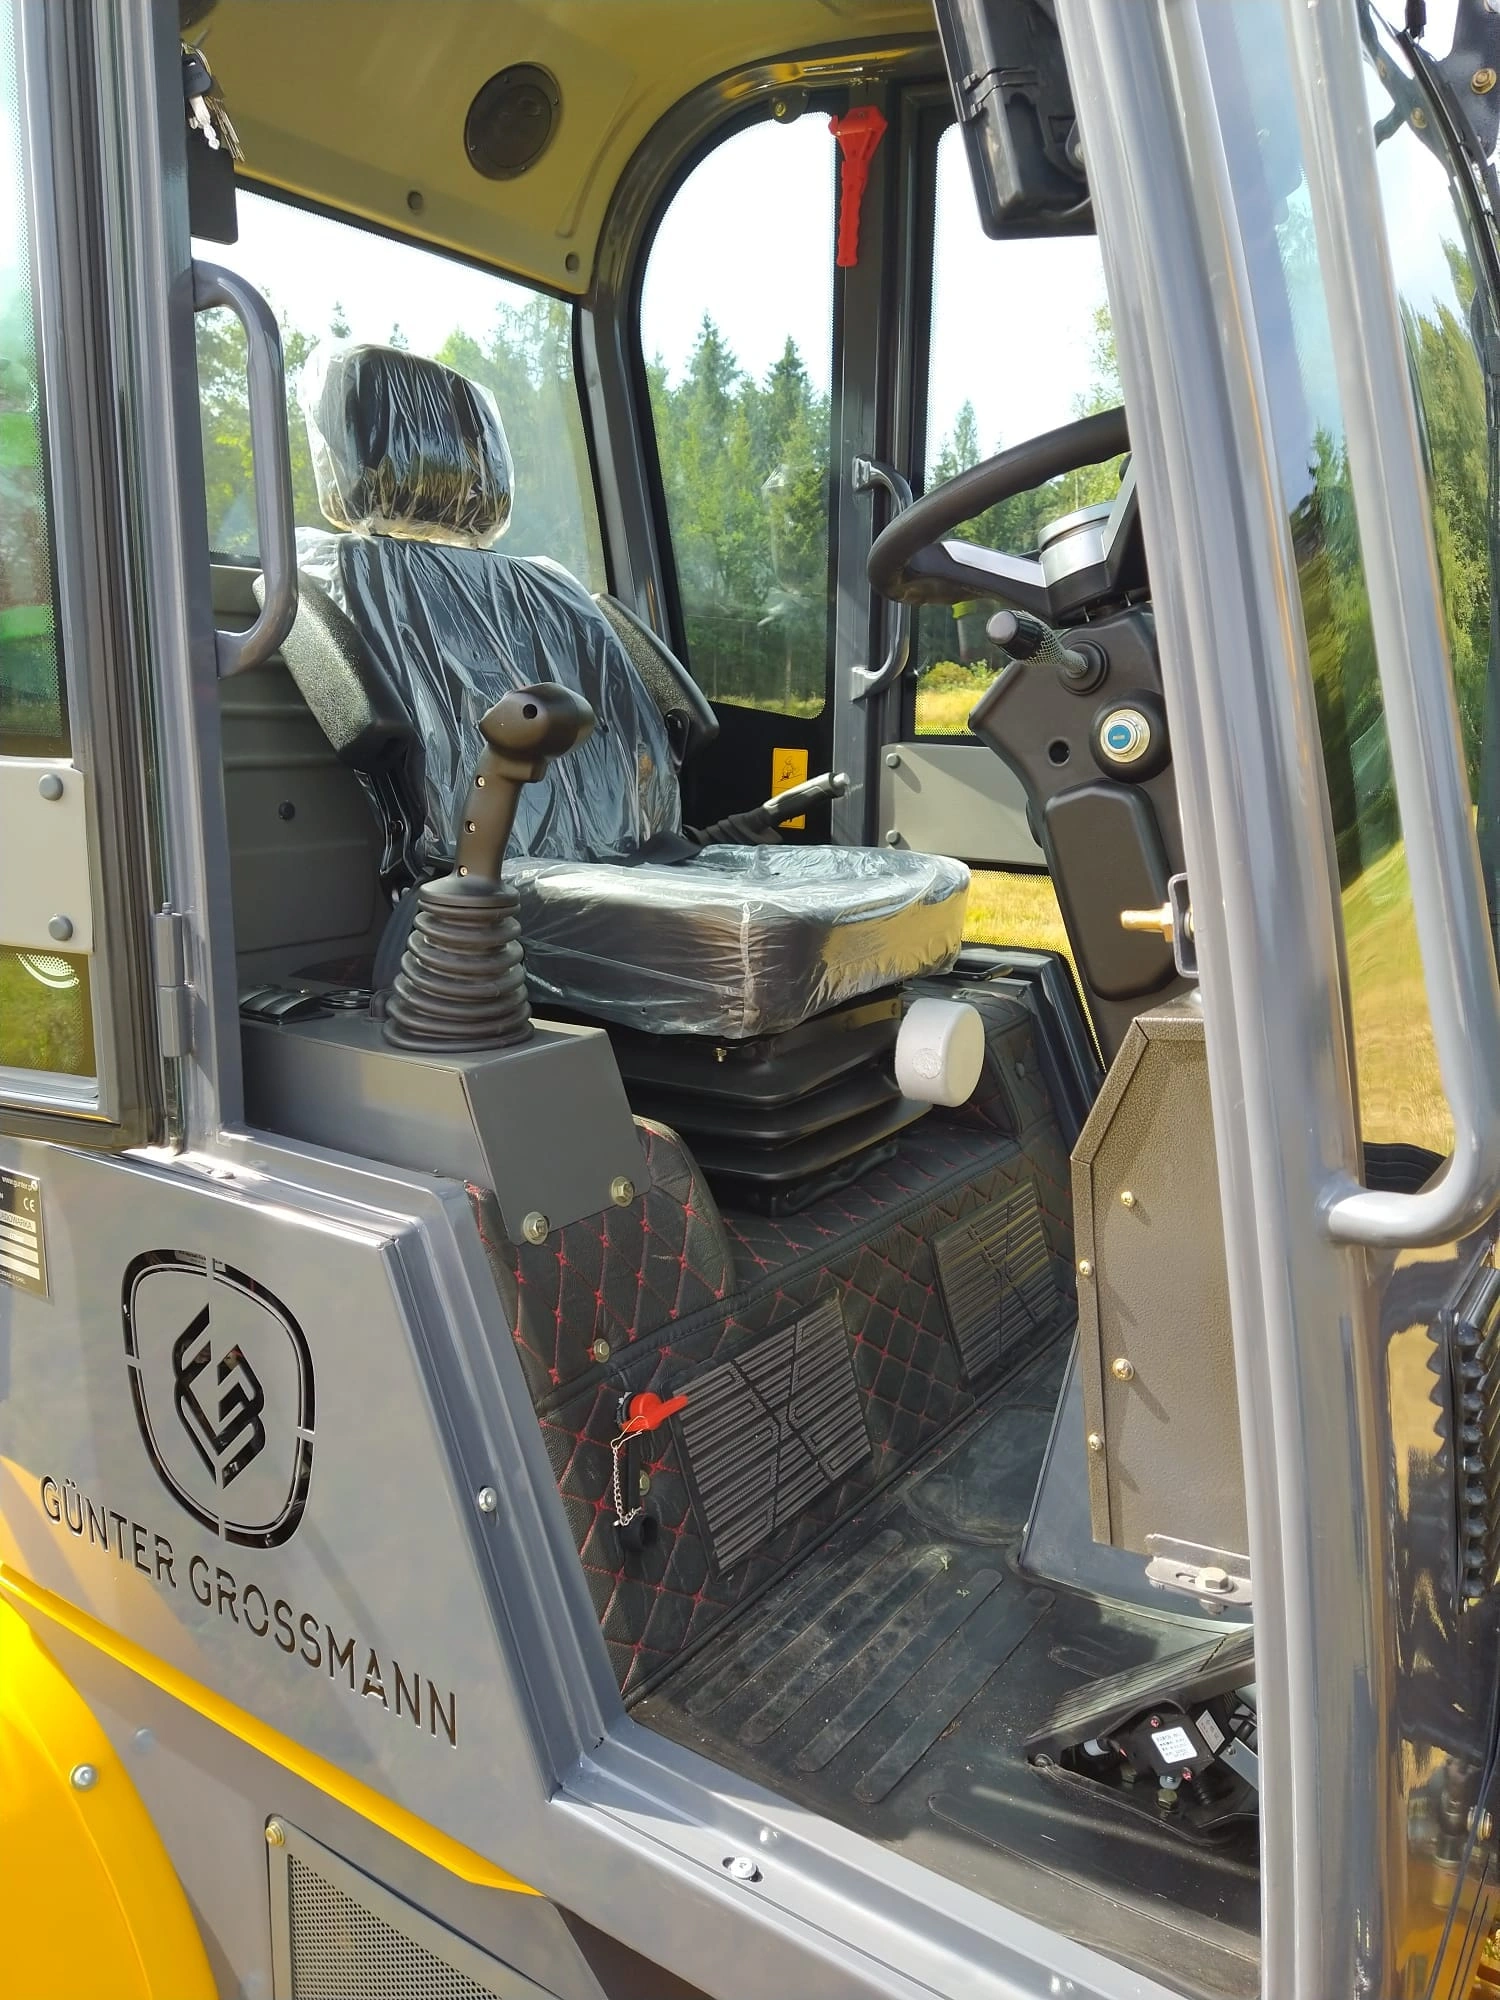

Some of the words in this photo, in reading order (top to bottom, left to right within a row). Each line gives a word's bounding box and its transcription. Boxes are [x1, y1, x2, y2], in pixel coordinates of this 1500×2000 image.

[23, 1197, 36, 1213] CE
[40, 1475, 177, 1588] GÜNTER
[188, 1555, 458, 1749] GROSSMANN
